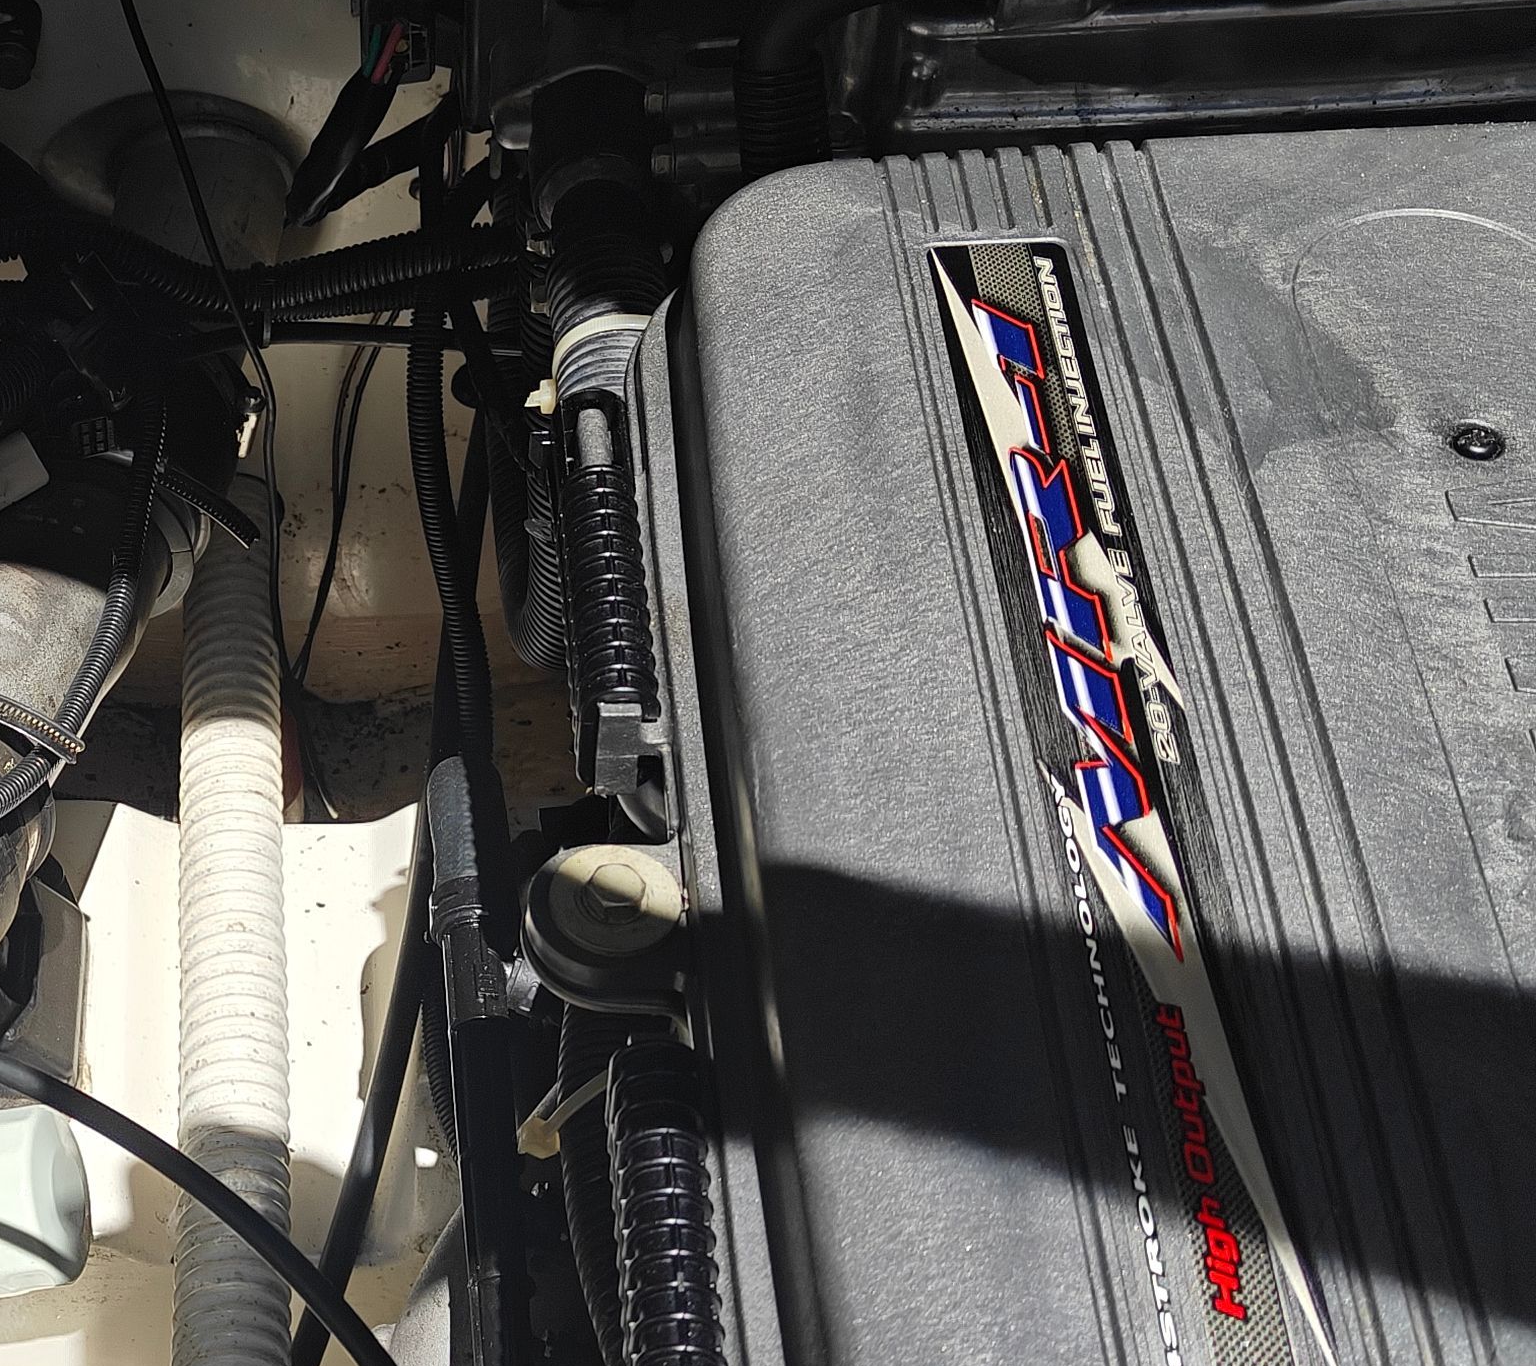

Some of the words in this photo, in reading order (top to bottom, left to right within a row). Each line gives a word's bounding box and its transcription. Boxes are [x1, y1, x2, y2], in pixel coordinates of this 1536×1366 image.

[1033, 256, 1096, 436] INJECTION
[1081, 439, 1123, 537] FUEL
[971, 298, 1184, 963] MR-1
[1108, 548, 1180, 765] 20-VALVE
[1050, 774, 1130, 1103] TECHNOLOGY
[1154, 1002, 1217, 1187] Output
[1196, 1194, 1248, 1322] High
